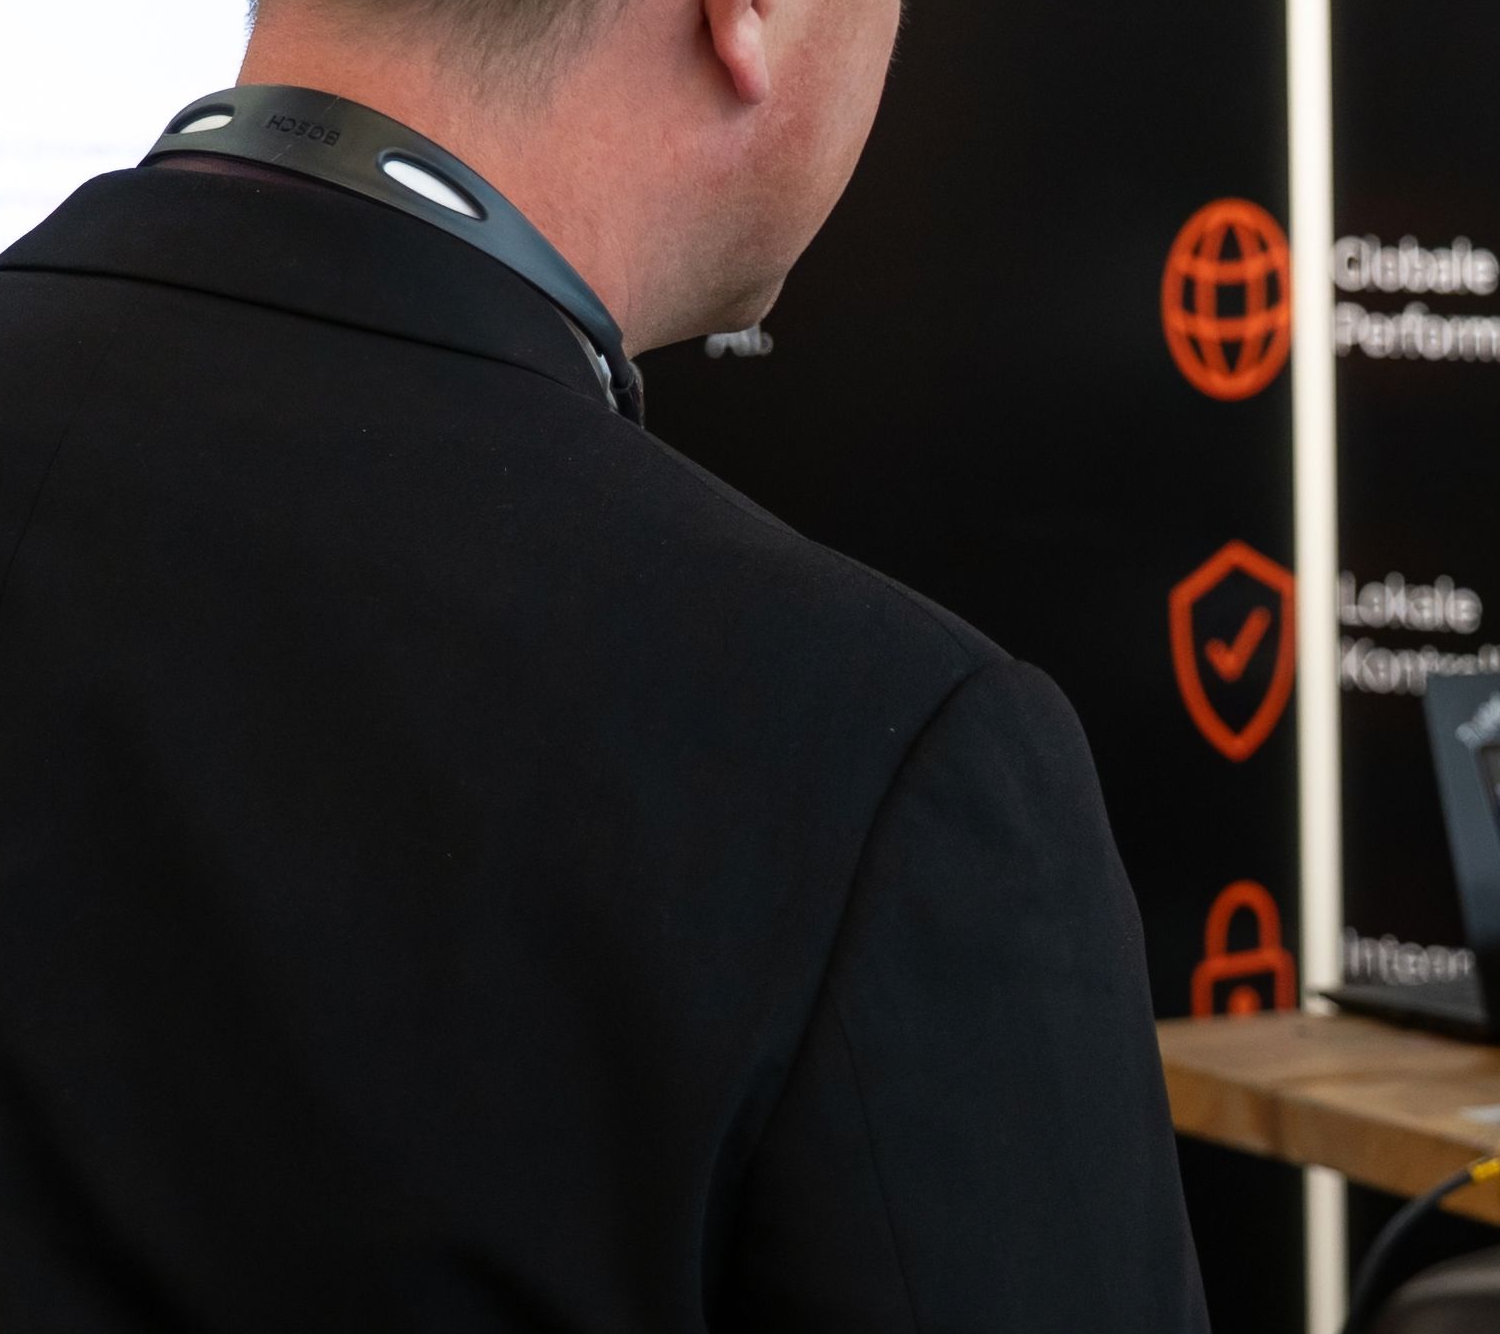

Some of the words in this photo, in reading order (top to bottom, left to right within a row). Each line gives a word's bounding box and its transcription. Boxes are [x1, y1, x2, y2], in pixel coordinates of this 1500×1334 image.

[266, 115, 341, 147] BOSCH
[1332, 234, 1500, 296] Globale
[1338, 570, 1483, 634] Lokale
